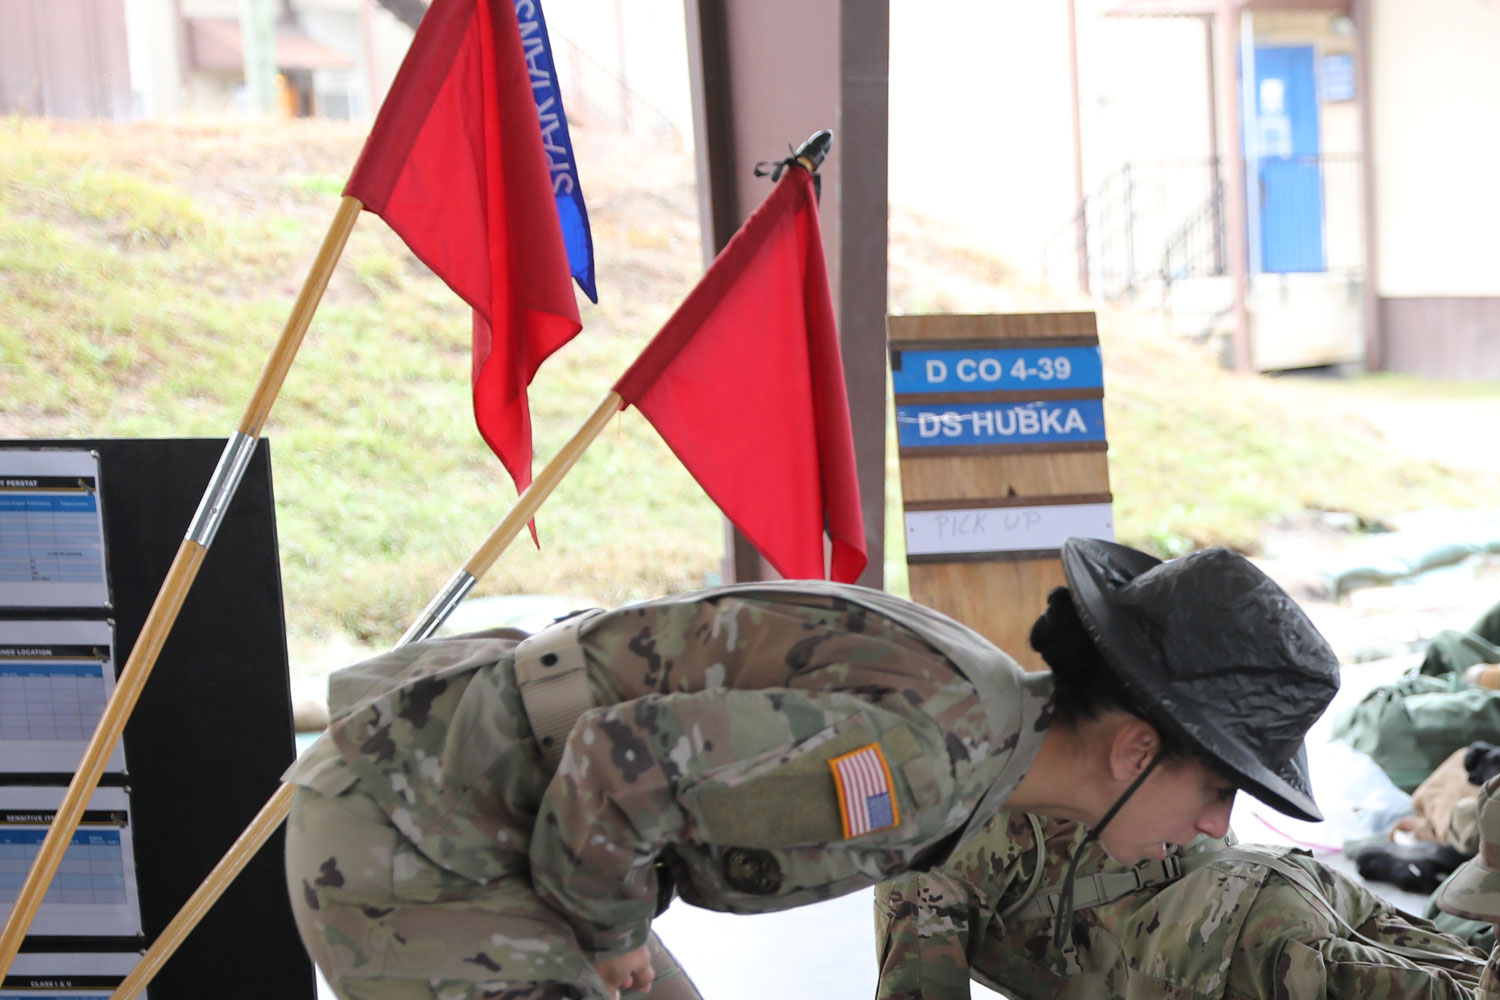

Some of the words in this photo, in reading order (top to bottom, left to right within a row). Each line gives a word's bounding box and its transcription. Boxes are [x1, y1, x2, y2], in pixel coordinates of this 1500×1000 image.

[926, 359, 947, 383] D
[956, 358, 1002, 382] CO
[1010, 356, 1071, 381] 4-39
[918, 411, 963, 437] DS
[972, 408, 1087, 436] HUBKA
[934, 511, 990, 541] PICK
[1004, 509, 1042, 531] UP
[16, 648, 52, 657] LOCATION
[6, 814, 40, 823] SENSITIVE
[31, 980, 53, 988] CLASS
